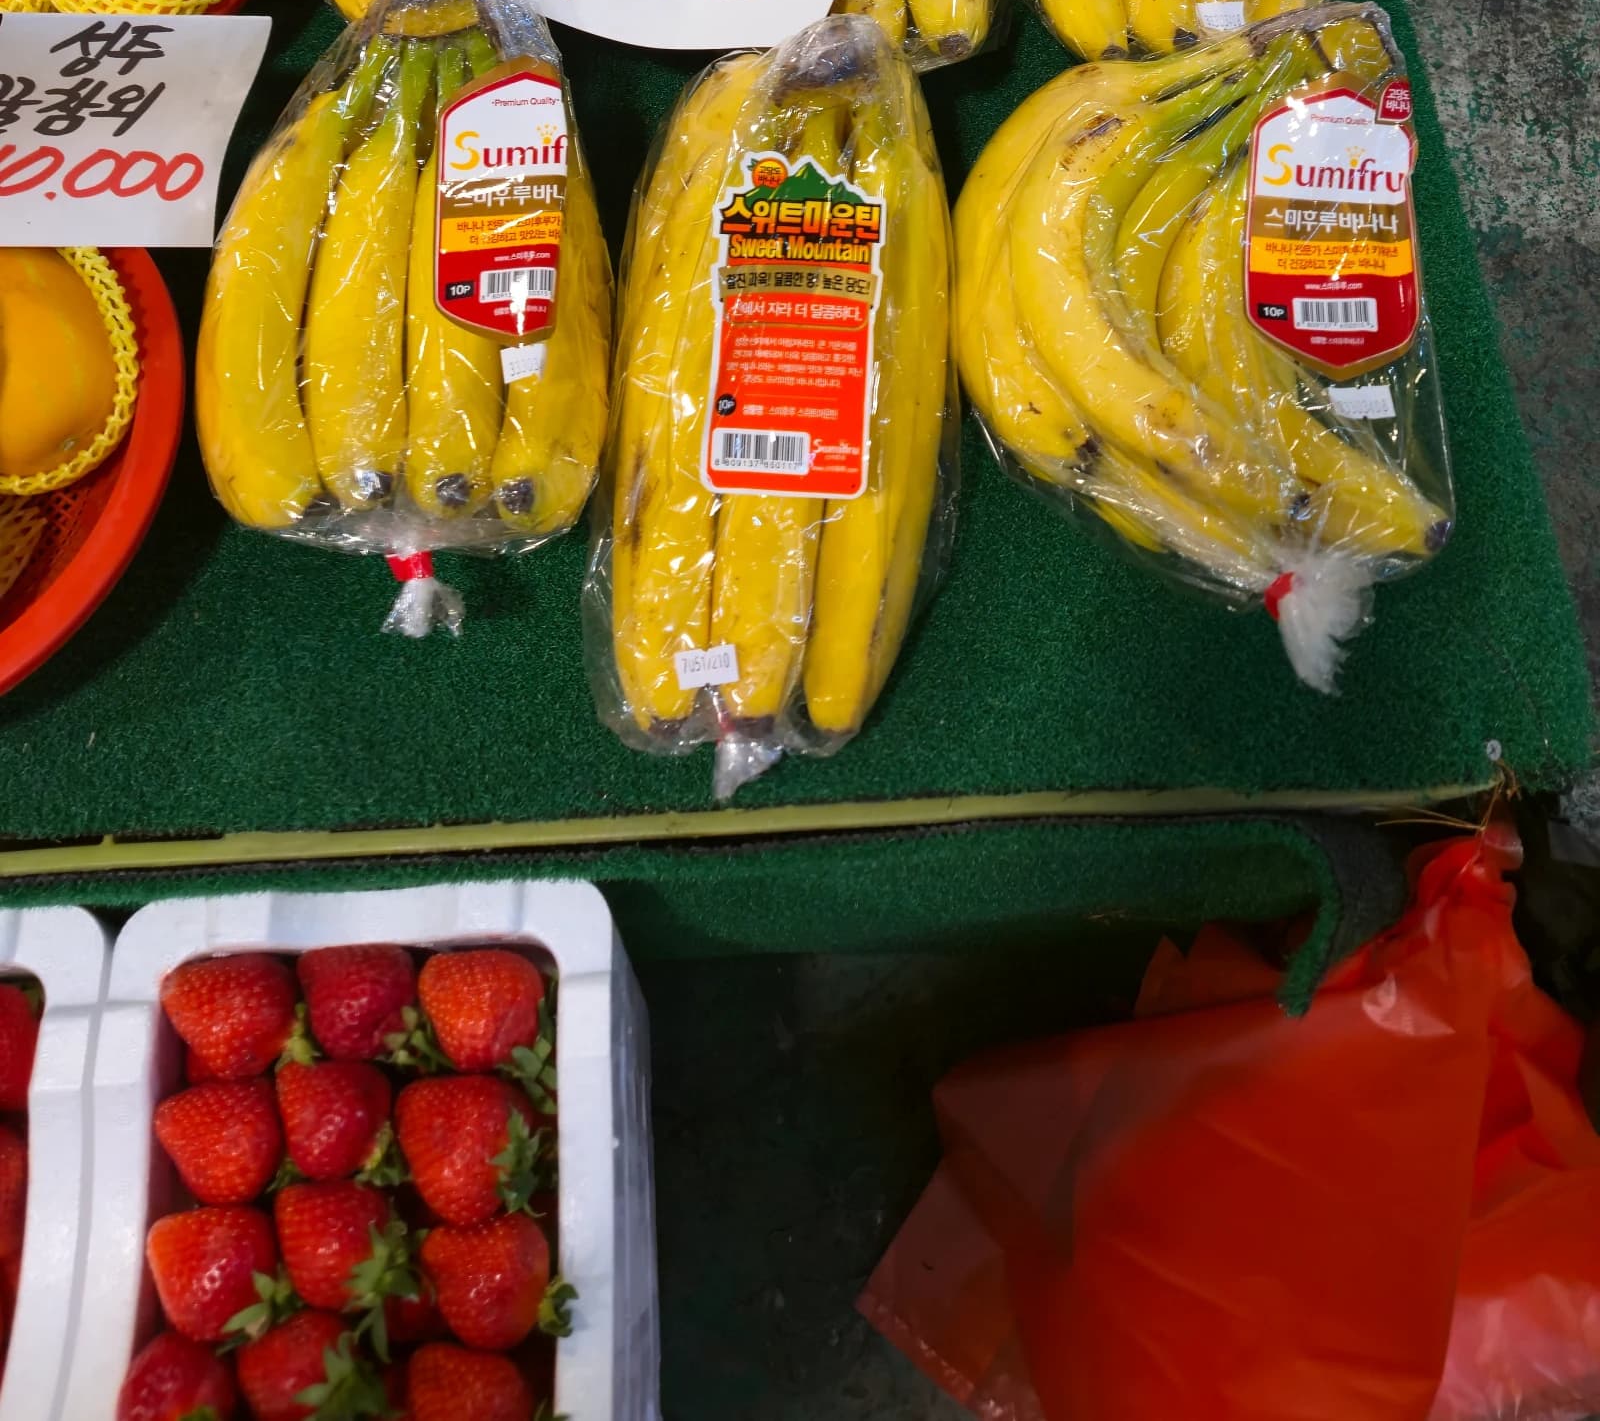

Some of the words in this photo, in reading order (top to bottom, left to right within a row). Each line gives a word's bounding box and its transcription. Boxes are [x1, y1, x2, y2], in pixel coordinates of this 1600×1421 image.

[450, 130, 567, 170] Sumif
[1263, 144, 1404, 193] Sumifru
[722, 196, 880, 240] 스위트마운틴
[1264, 208, 1398, 234] 스미후루바나나
[730, 234, 785, 259] Sweet
[787, 236, 869, 262] Mountain
[450, 285, 471, 295] 10P
[795, 303, 807, 317] 더
[1263, 307, 1284, 317] 10P
